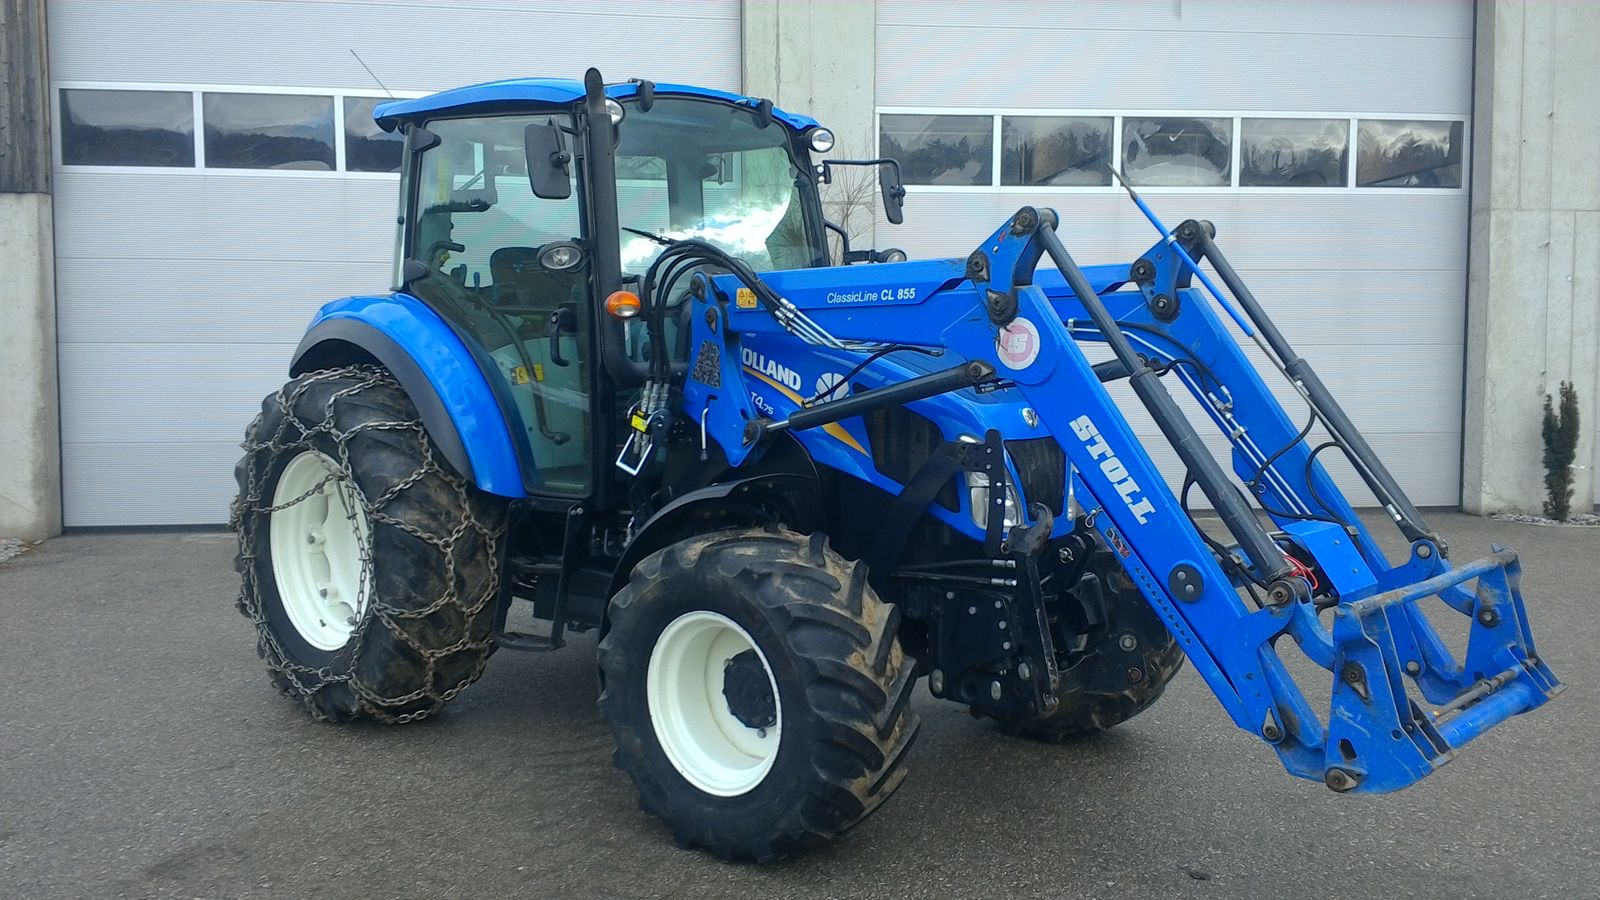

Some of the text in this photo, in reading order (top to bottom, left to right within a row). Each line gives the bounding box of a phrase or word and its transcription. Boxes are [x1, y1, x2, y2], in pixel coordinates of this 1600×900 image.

[826, 287, 916, 304] ClassicLine CL 855
[740, 346, 802, 391] OLLAND
[1068, 414, 1156, 526] STOLL
